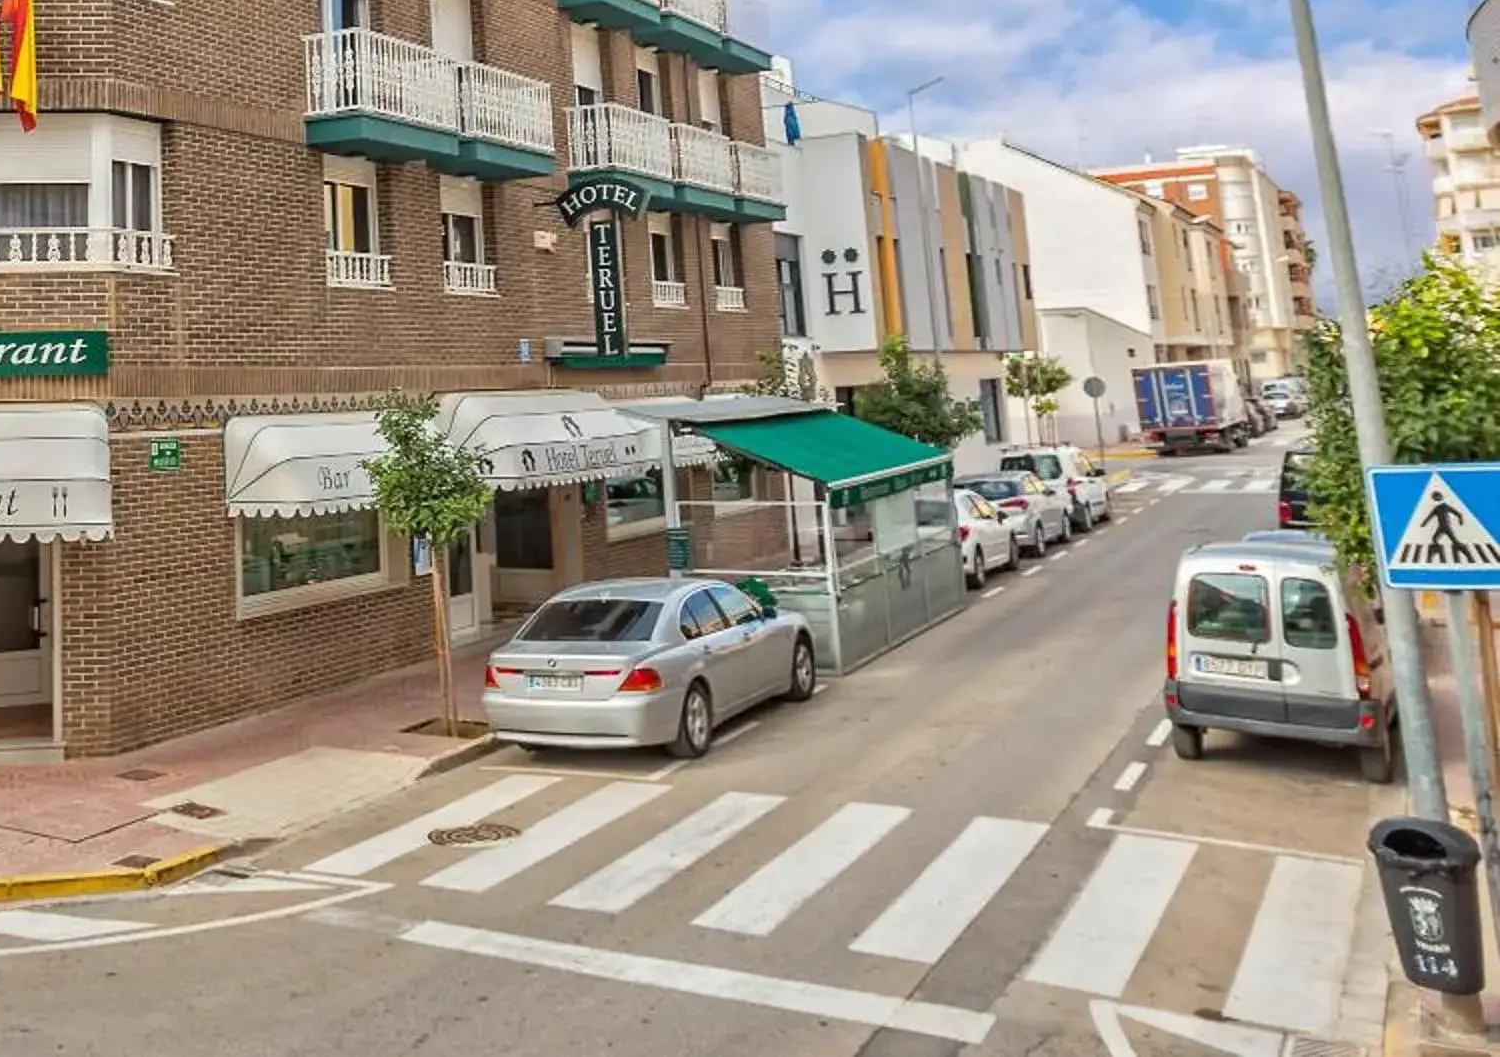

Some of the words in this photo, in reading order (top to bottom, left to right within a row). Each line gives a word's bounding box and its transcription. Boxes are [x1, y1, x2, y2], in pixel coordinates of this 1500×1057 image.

[561, 184, 639, 216] HOTEL
[594, 224, 619, 356] TERUEL
[821, 270, 867, 317] H
[545, 445, 579, 472] Hotel
[580, 442, 618, 469] Teruel
[317, 465, 351, 491] Bar
